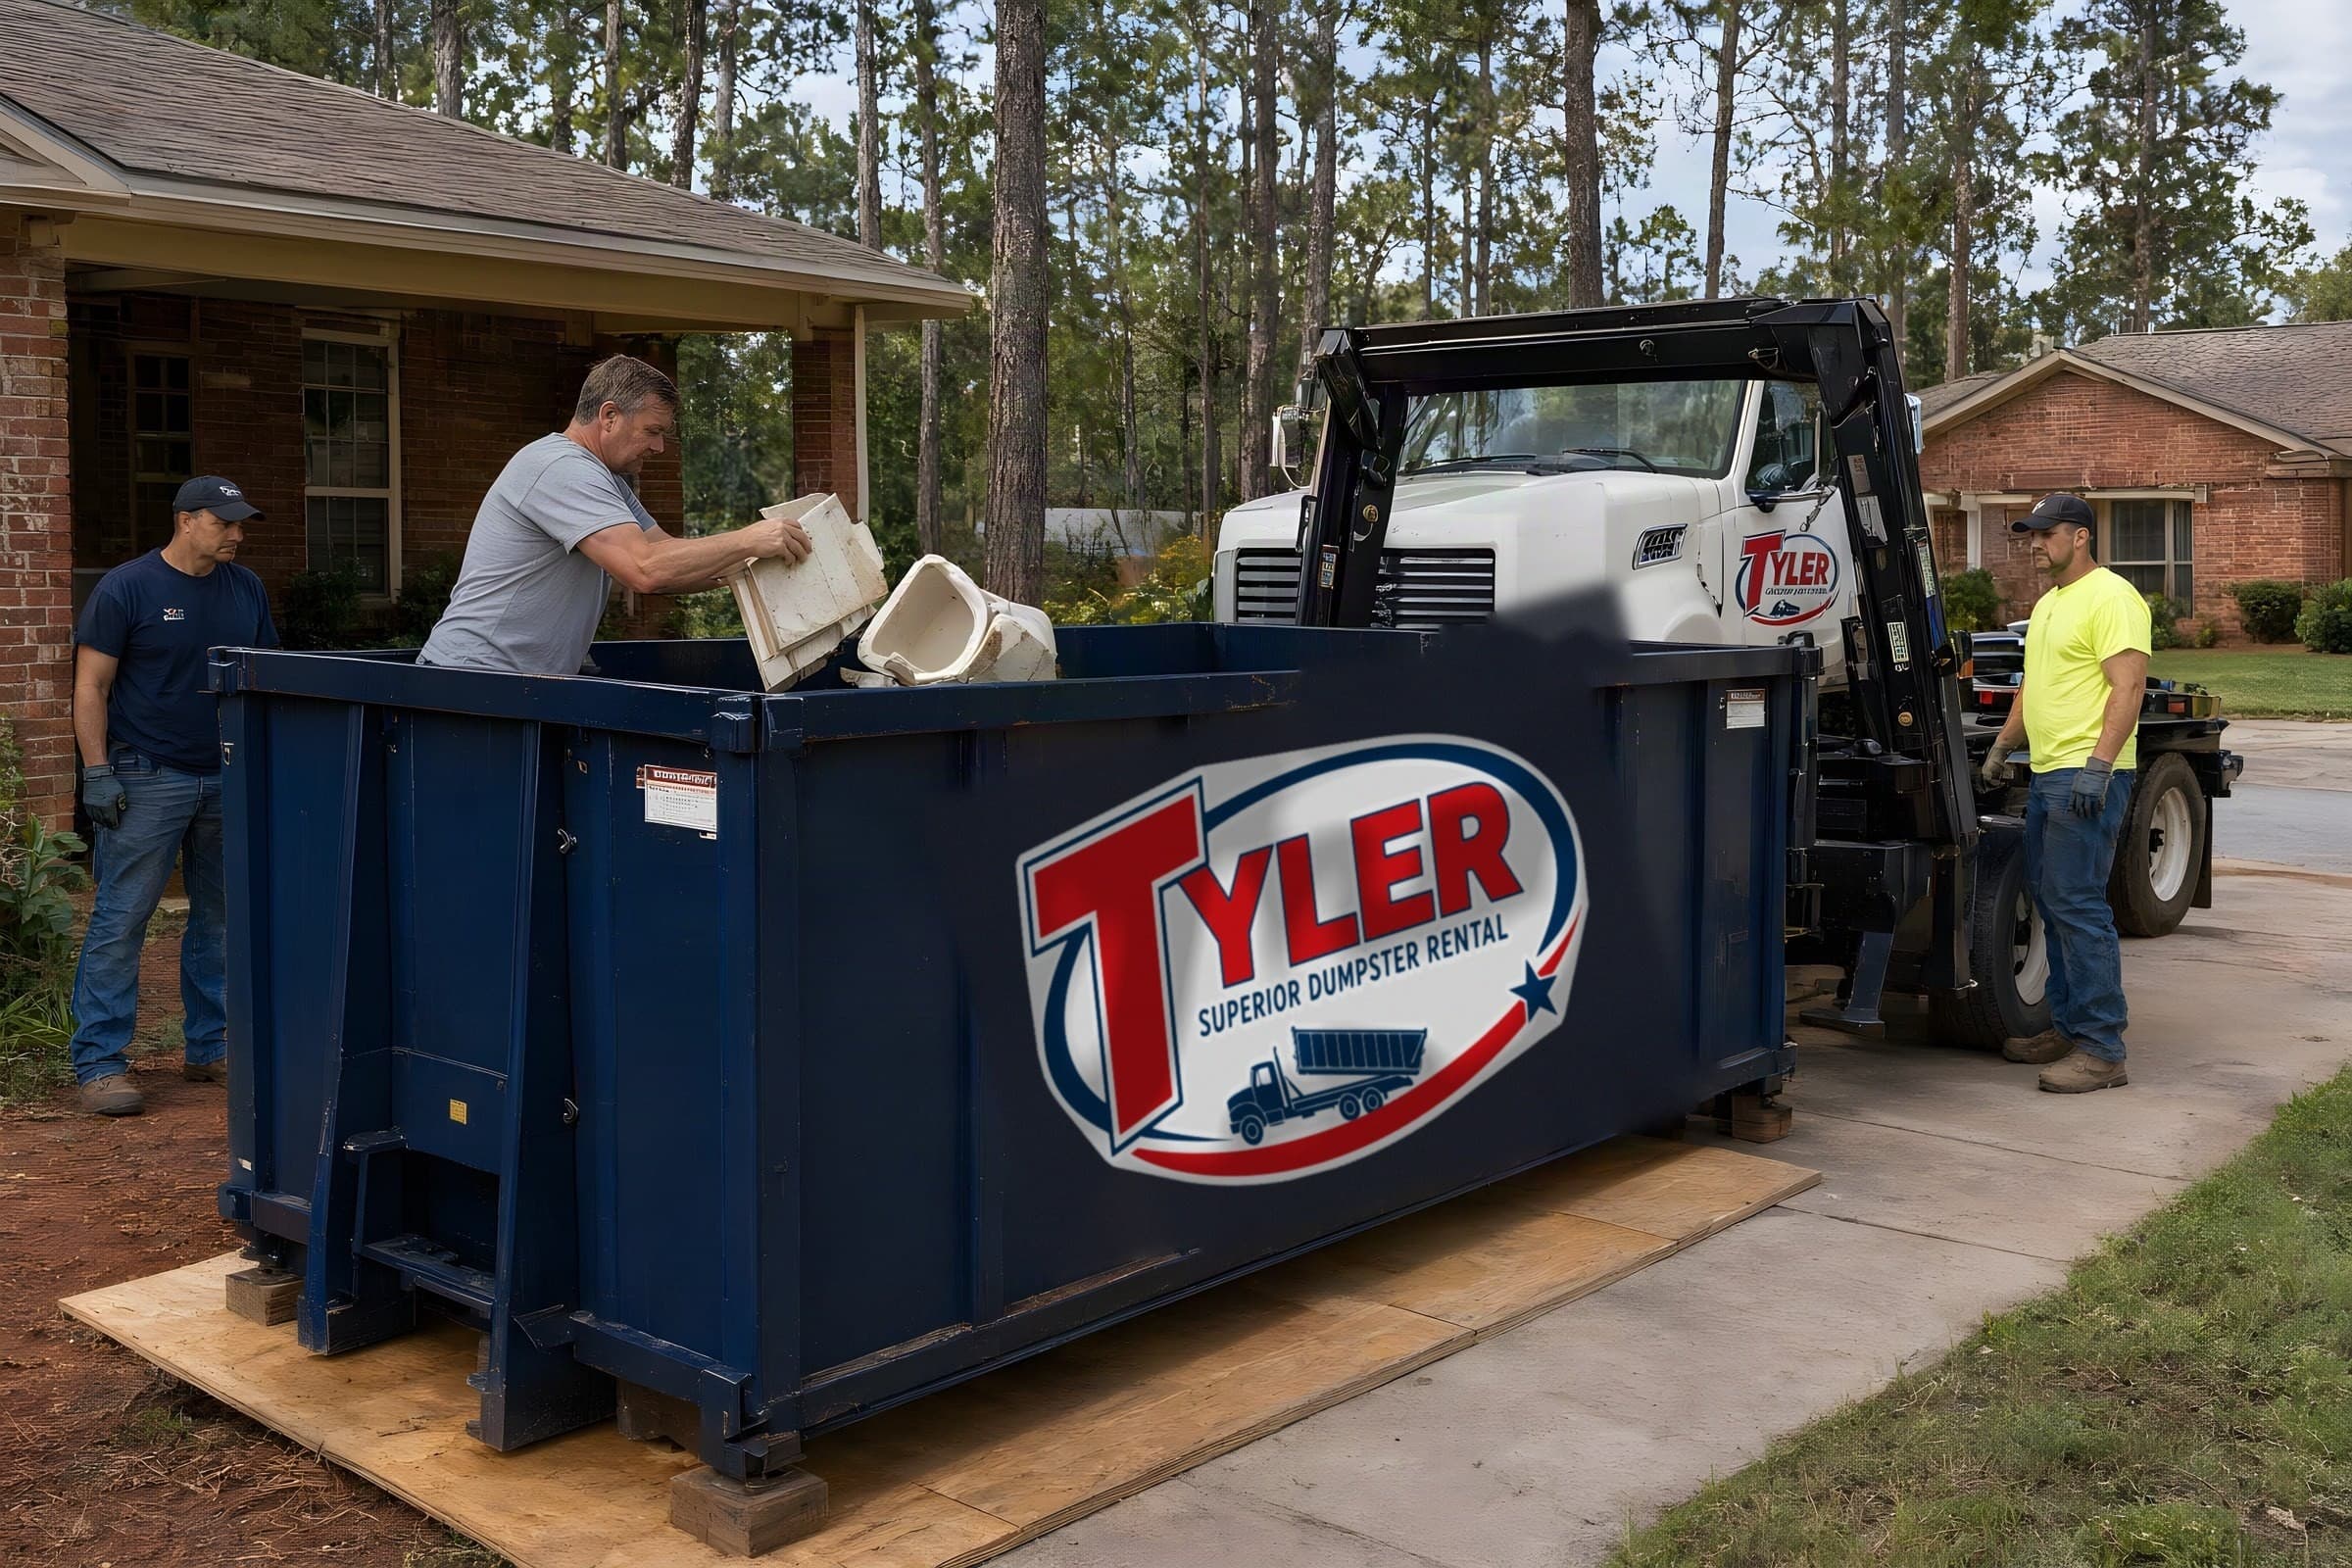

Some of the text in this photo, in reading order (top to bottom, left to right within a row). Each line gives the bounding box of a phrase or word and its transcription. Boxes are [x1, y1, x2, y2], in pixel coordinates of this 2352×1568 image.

[1740, 530, 1831, 615] TYLER
[1023, 777, 1524, 1154] TYLER
[1199, 913, 1509, 1037] SUPERIOR DUMPSTER RENTAL
